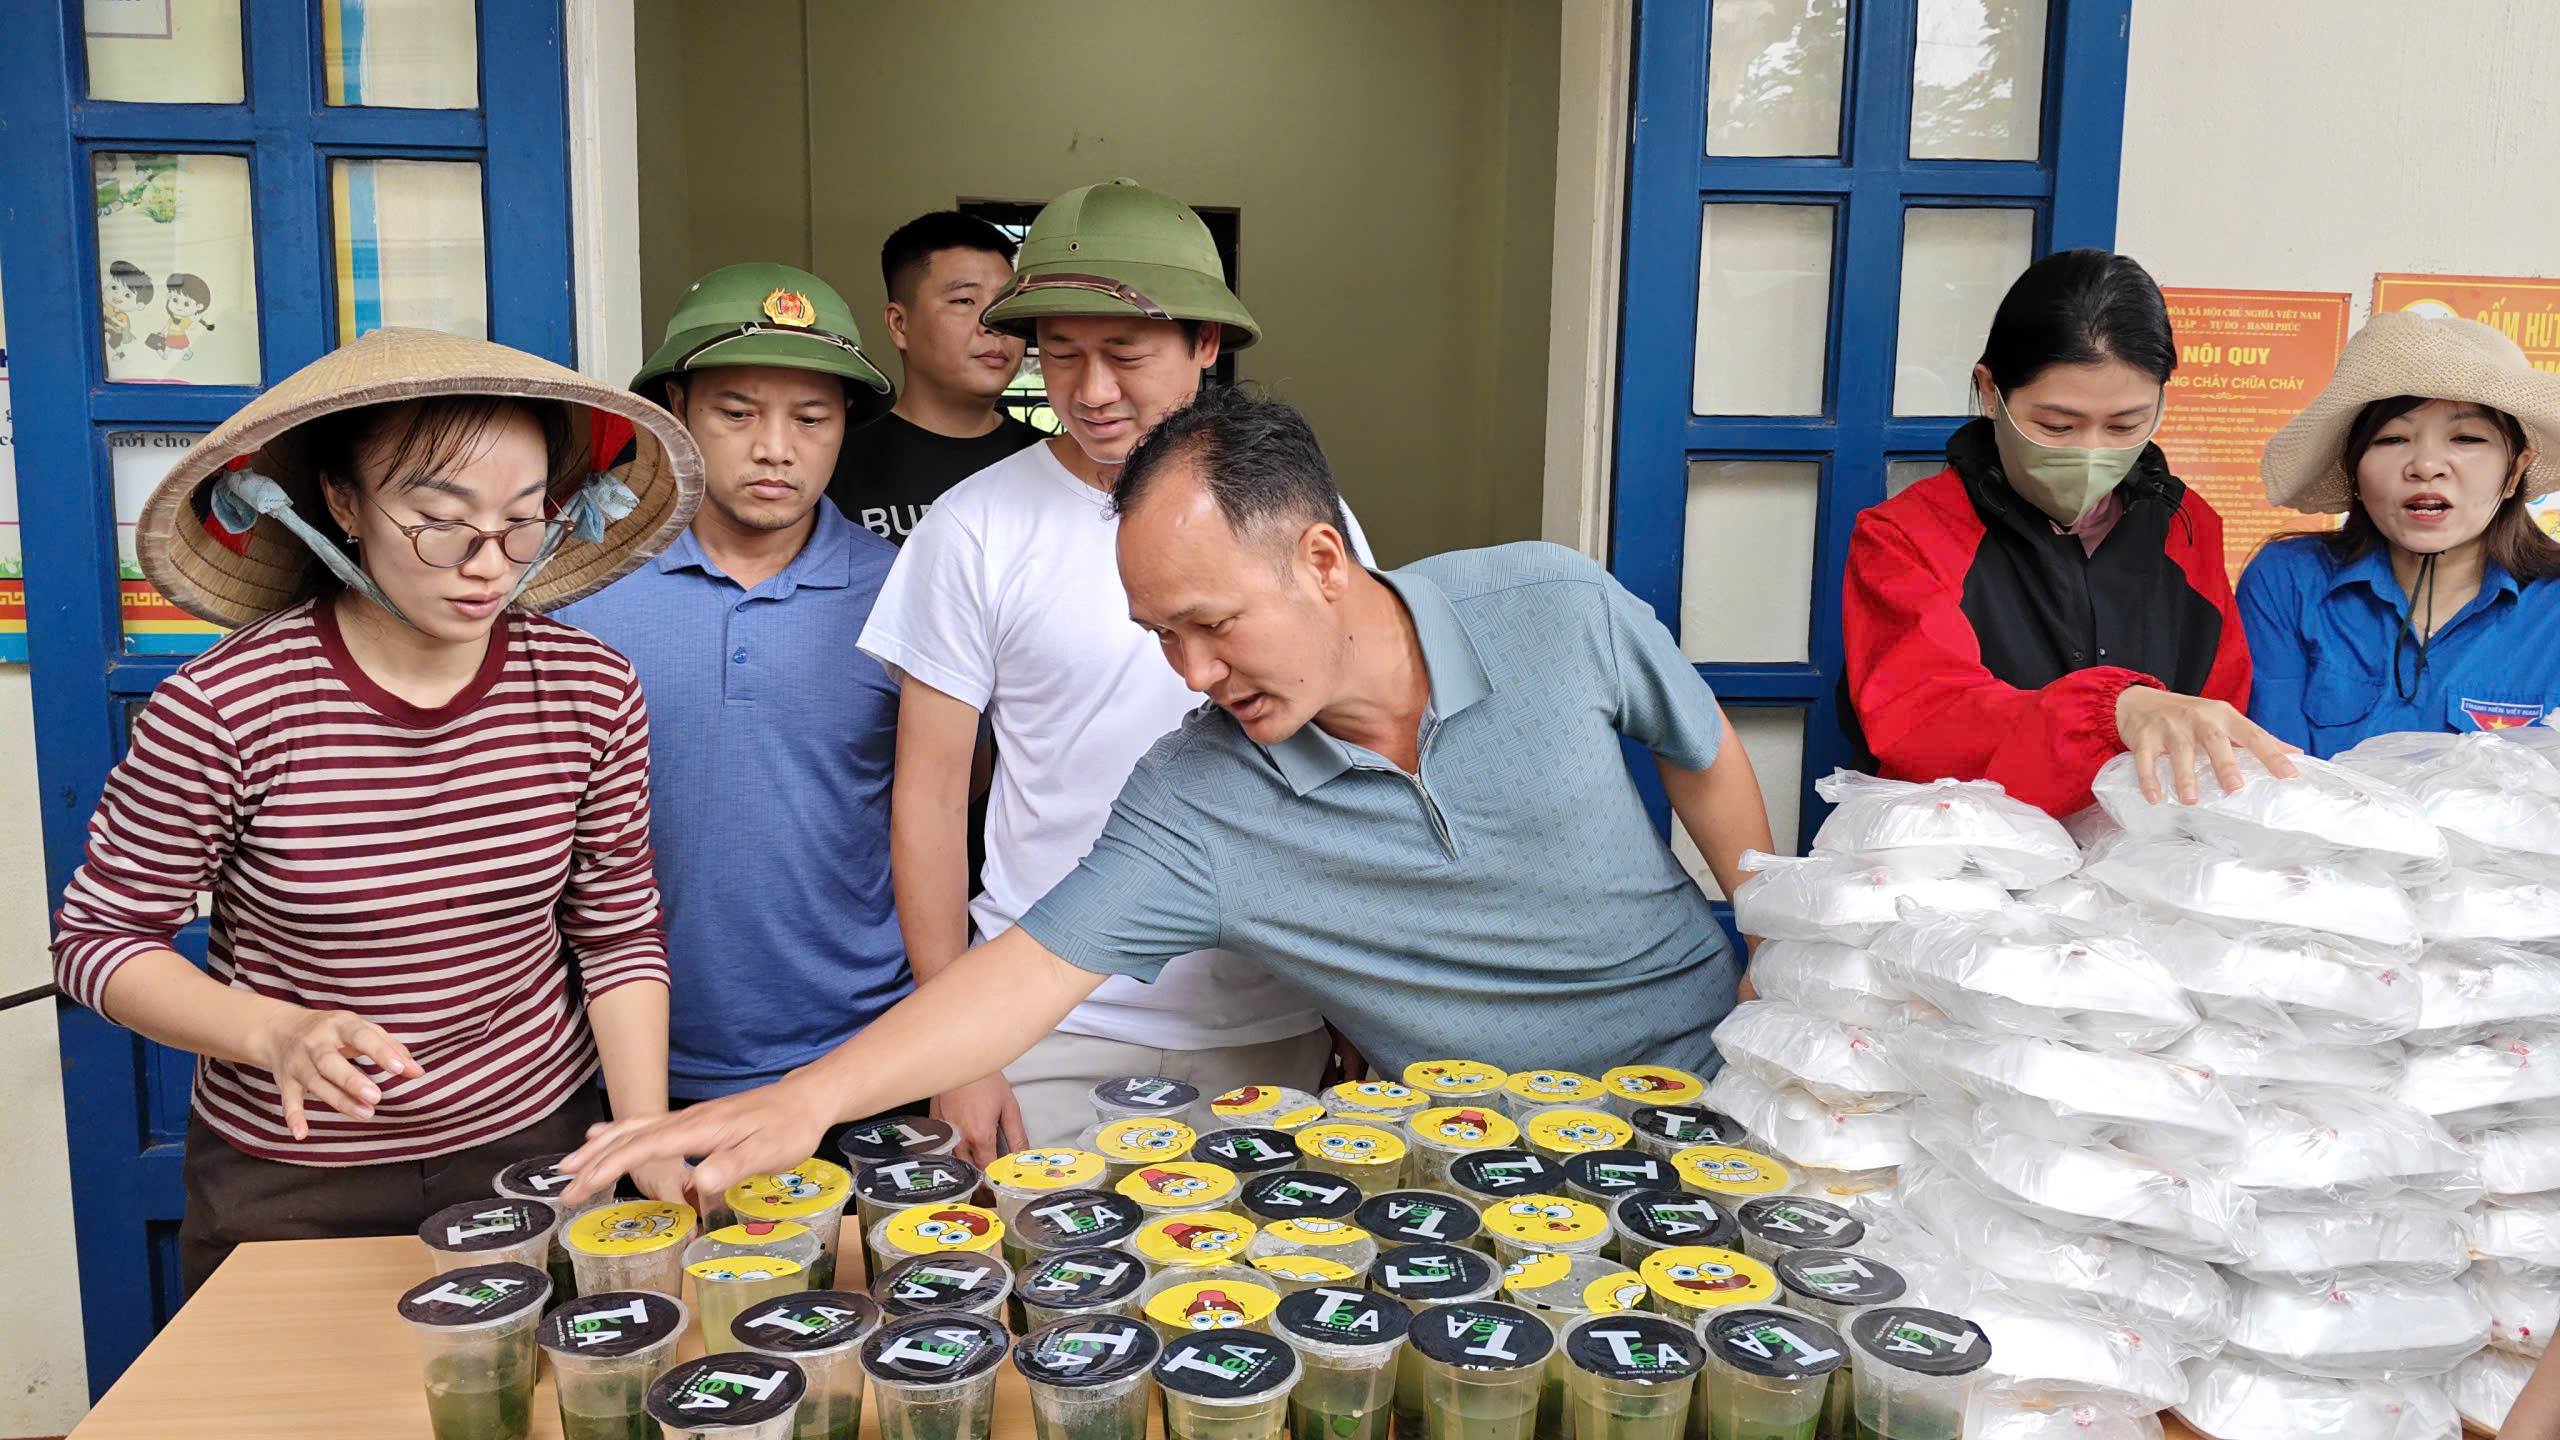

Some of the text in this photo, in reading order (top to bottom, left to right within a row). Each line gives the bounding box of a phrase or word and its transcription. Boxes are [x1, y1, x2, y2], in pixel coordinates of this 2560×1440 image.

[2183, 343, 2271, 367] NỘI QUY
[2192, 373, 2229, 388] CHÁY
[2270, 376, 2305, 390] CHÁY
[153, 433, 191, 448] cho
[861, 504, 933, 538] BU
